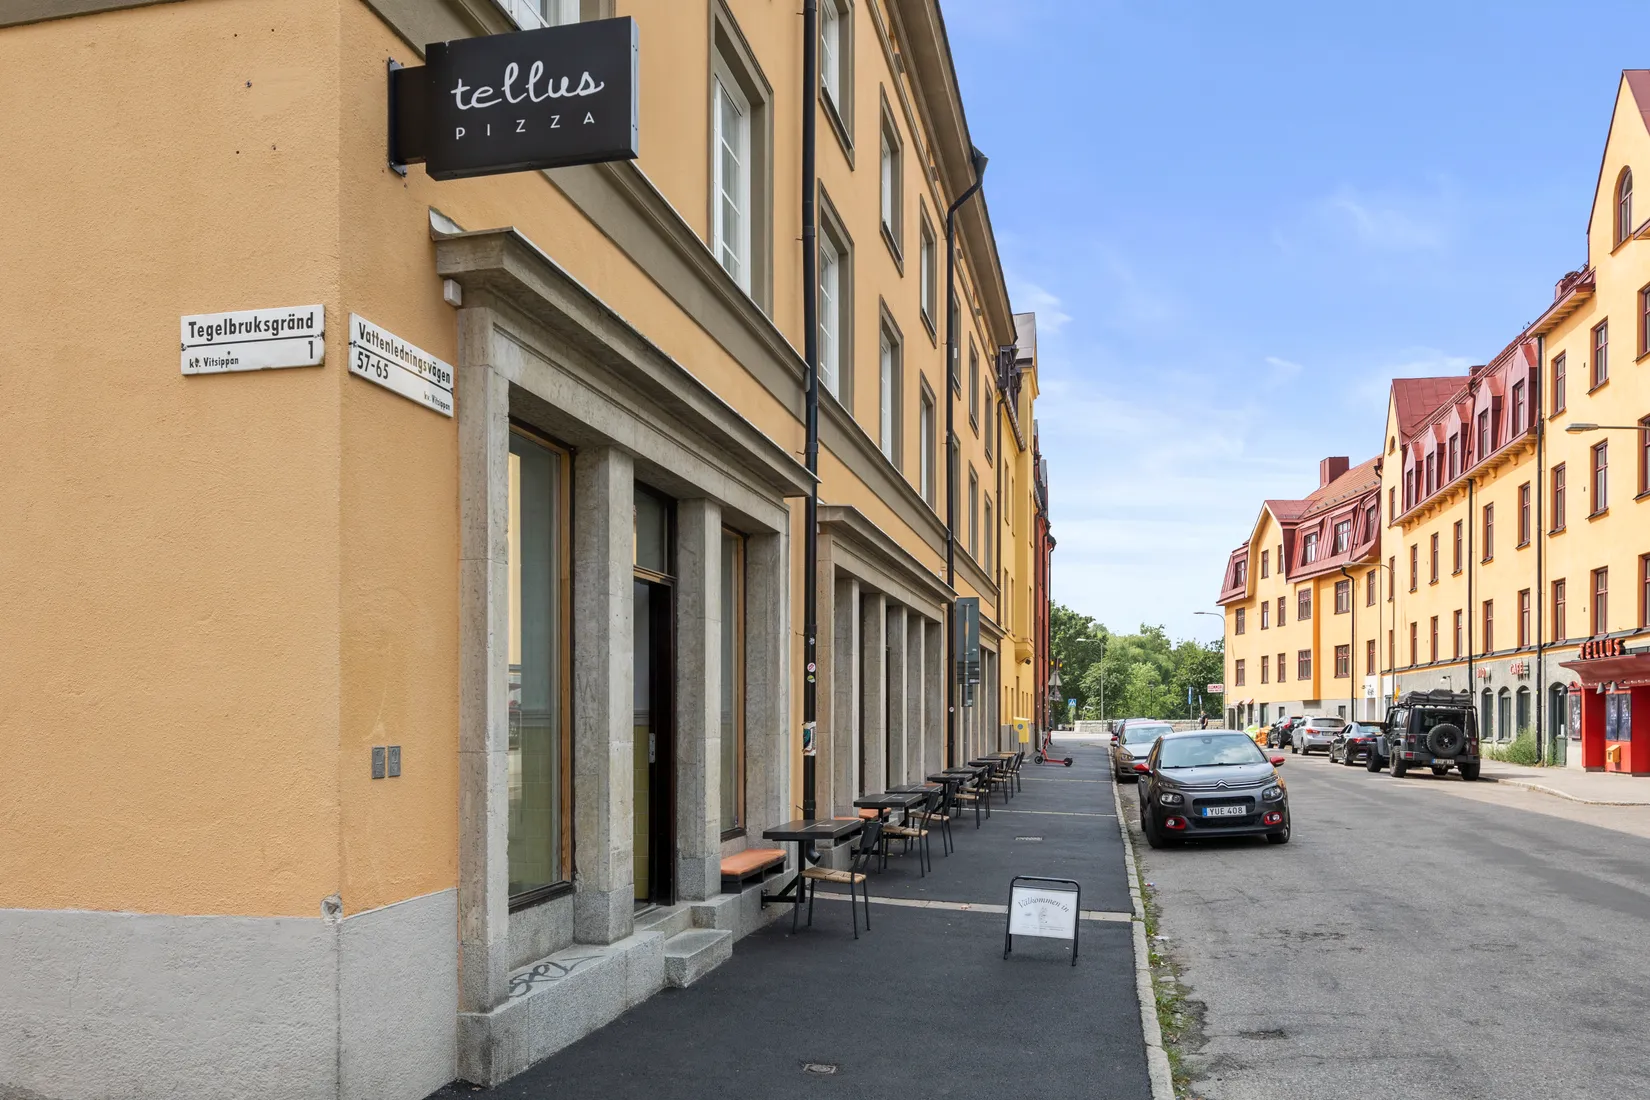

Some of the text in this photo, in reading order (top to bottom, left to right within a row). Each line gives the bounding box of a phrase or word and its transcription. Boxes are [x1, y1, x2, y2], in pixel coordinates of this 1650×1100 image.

[450, 60, 605, 110] tellus
[455, 111, 595, 140] PIZZA
[188, 311, 314, 341] Tegelbruksgränd
[308, 340, 314, 359] 1
[358, 321, 451, 384] Vattenledningsvägen
[203, 356, 239, 369] Vitsippan
[357, 350, 389, 380] 57-65
[1579, 638, 1621, 660] TELLUS
[1209, 806, 1243, 816] YUE 408
[1018, 896, 1061, 909] Välkommen
